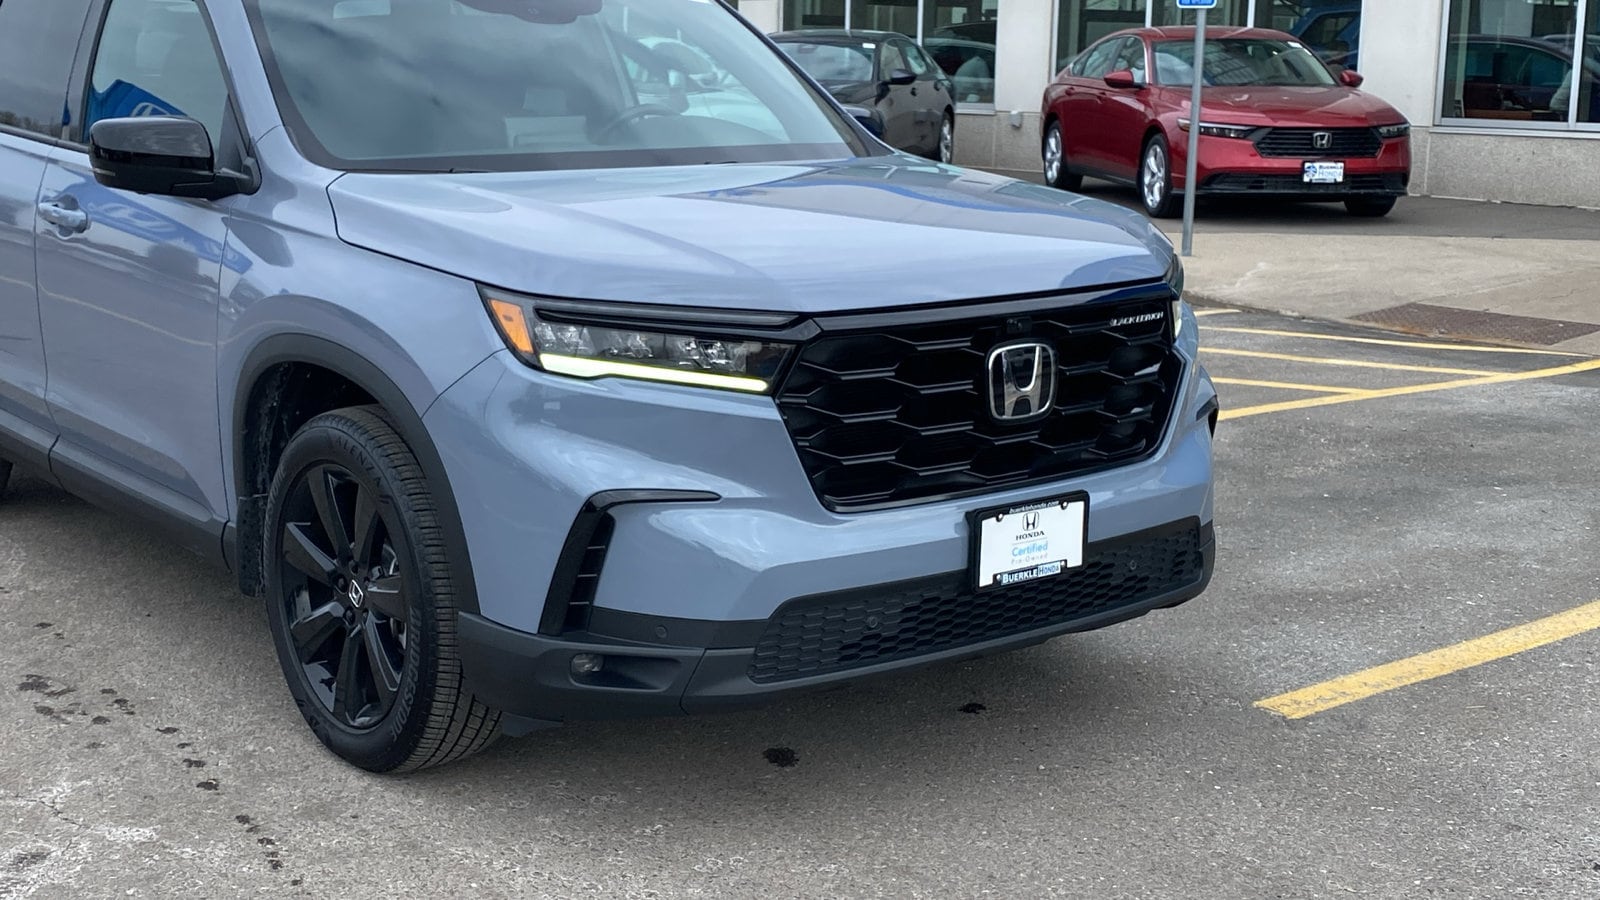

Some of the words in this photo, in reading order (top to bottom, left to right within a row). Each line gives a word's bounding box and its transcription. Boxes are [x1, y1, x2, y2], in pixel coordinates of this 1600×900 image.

[1015, 530, 1045, 540] HONDA
[1011, 540, 1049, 557] Certified
[1002, 568, 1038, 584] BUERKLE
[1038, 563, 1060, 576] HONDA
[390, 606, 422, 742] BRIDGESTONE
